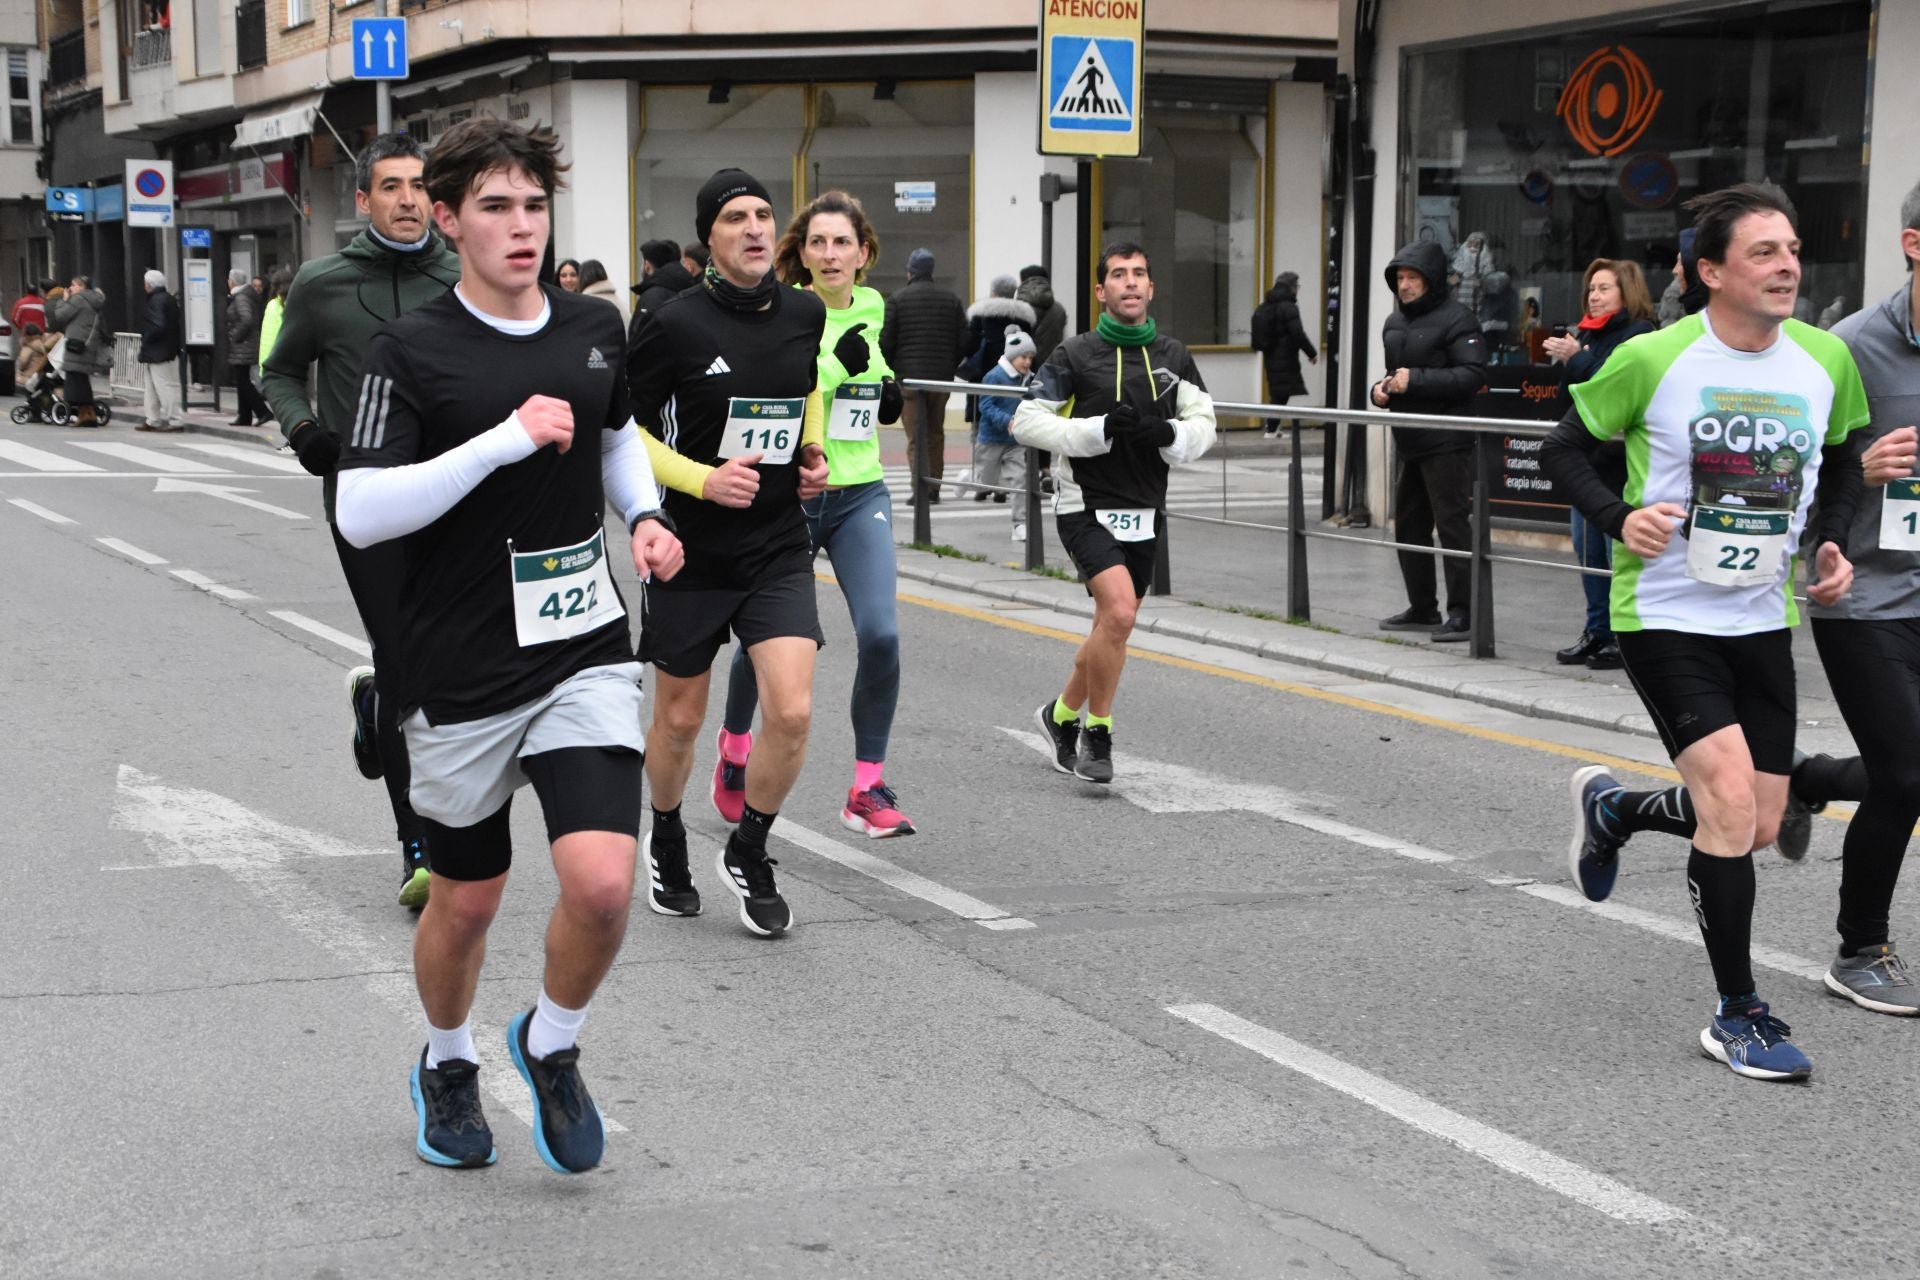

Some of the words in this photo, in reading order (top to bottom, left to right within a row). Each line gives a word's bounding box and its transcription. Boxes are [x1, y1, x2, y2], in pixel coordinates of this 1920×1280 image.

[1049, 0, 1138, 19] ATENCION
[850, 409, 871, 428] 78
[741, 428, 789, 450] 116
[1695, 415, 1811, 453] OGRO
[1107, 512, 1141, 531] 251
[1717, 545, 1760, 571] 22
[539, 580, 598, 621] 422
